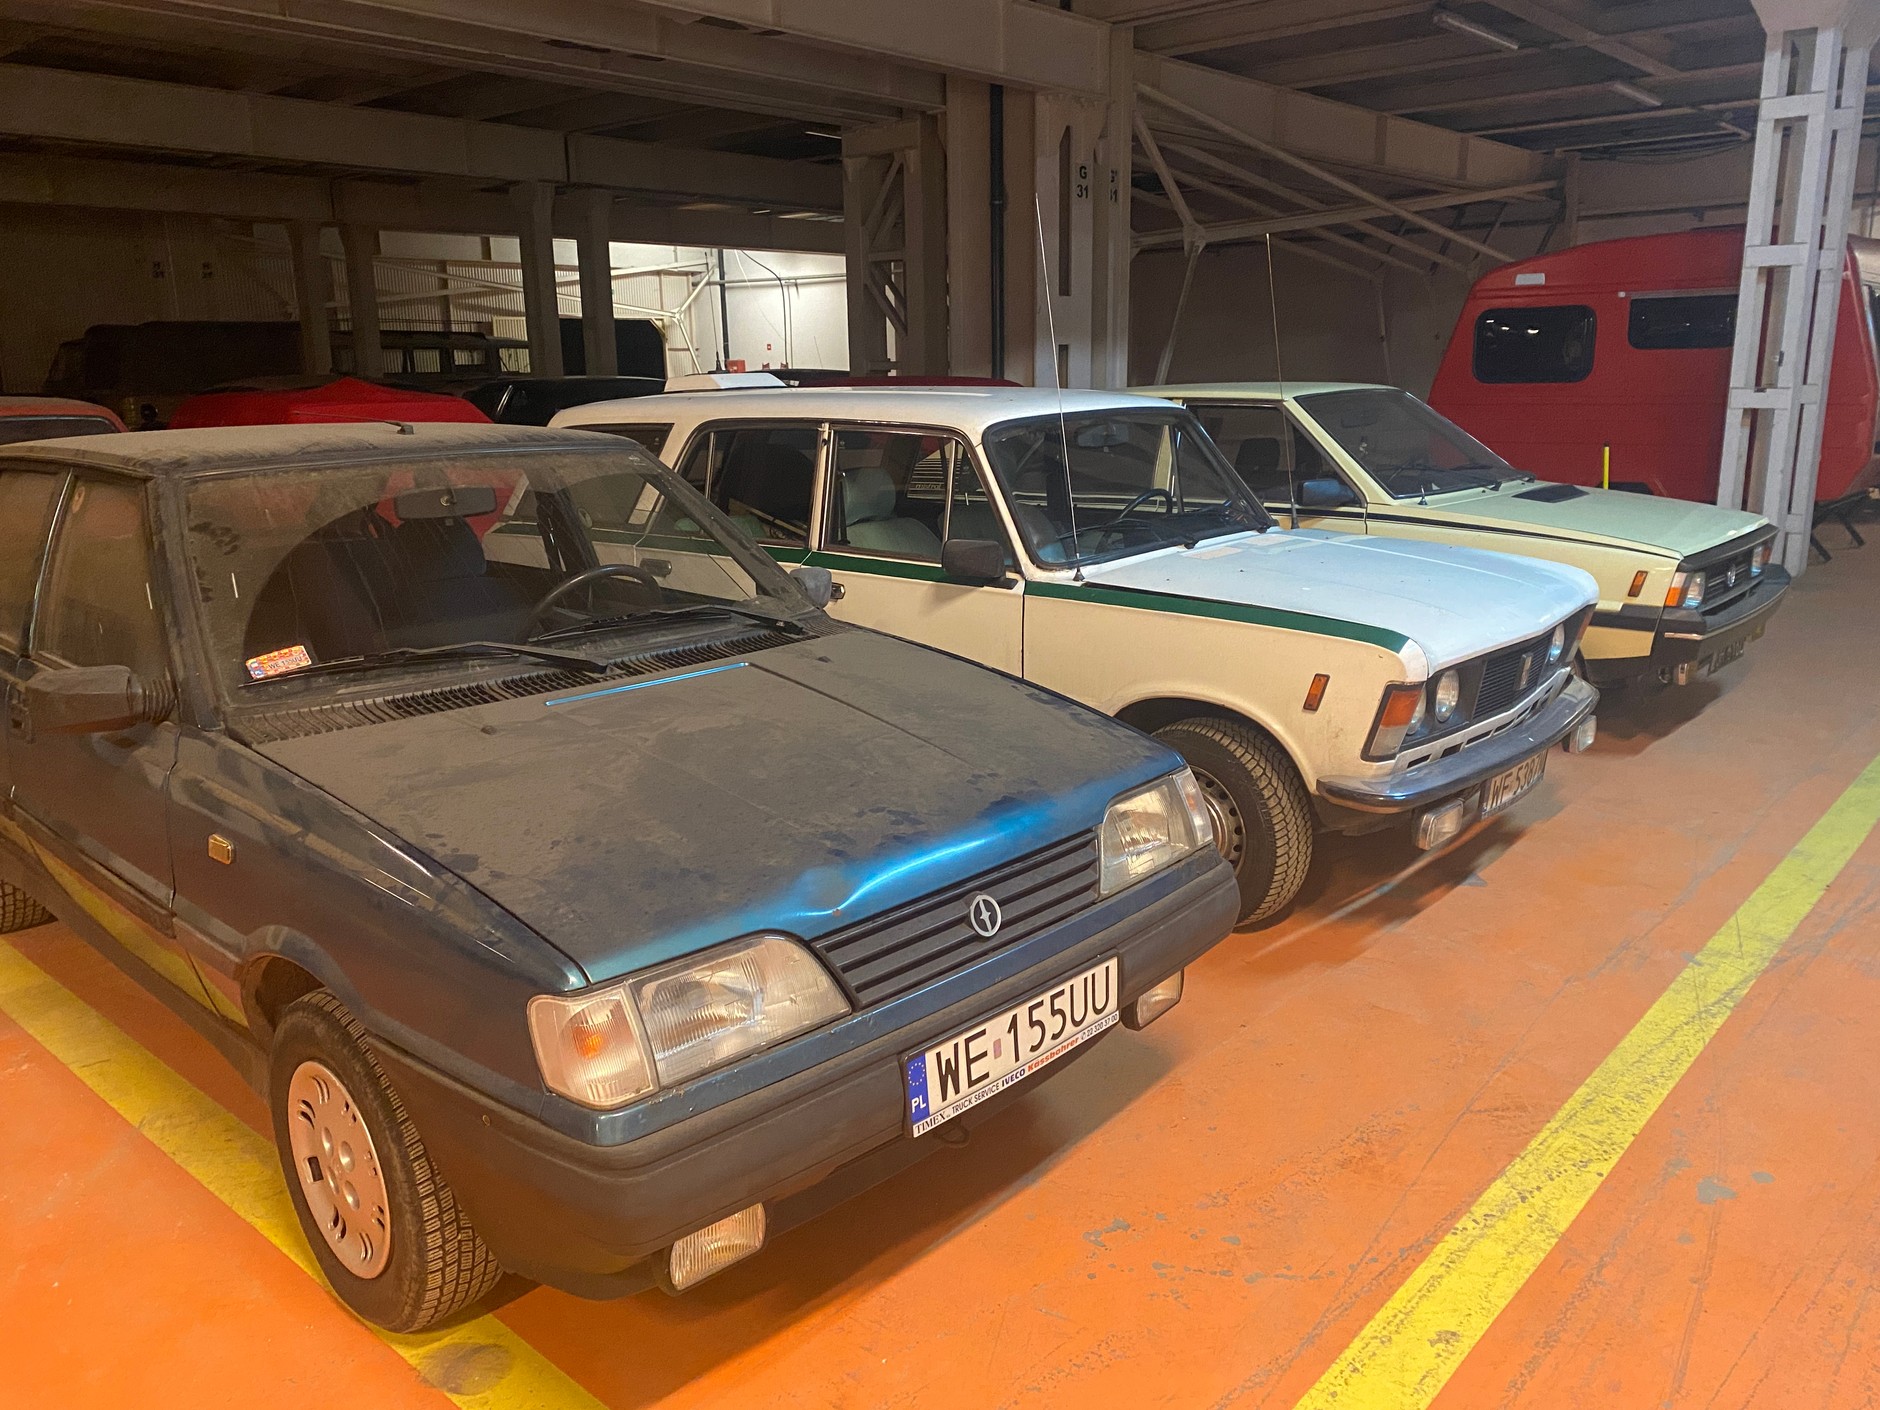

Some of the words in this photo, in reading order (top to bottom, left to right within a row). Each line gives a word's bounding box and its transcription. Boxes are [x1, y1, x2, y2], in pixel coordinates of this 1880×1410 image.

[1080, 165, 1087, 179] G
[1077, 184, 1088, 199] 31
[936, 1028, 990, 1103] WE
[1007, 965, 1110, 1064] 155UU
[911, 1095, 926, 1113] PL
[915, 1111, 945, 1134] TIMEX
[952, 1097, 973, 1114] TRUCK
[973, 1082, 1000, 1103] SERVICE
[1001, 1068, 1026, 1087] IVECO
